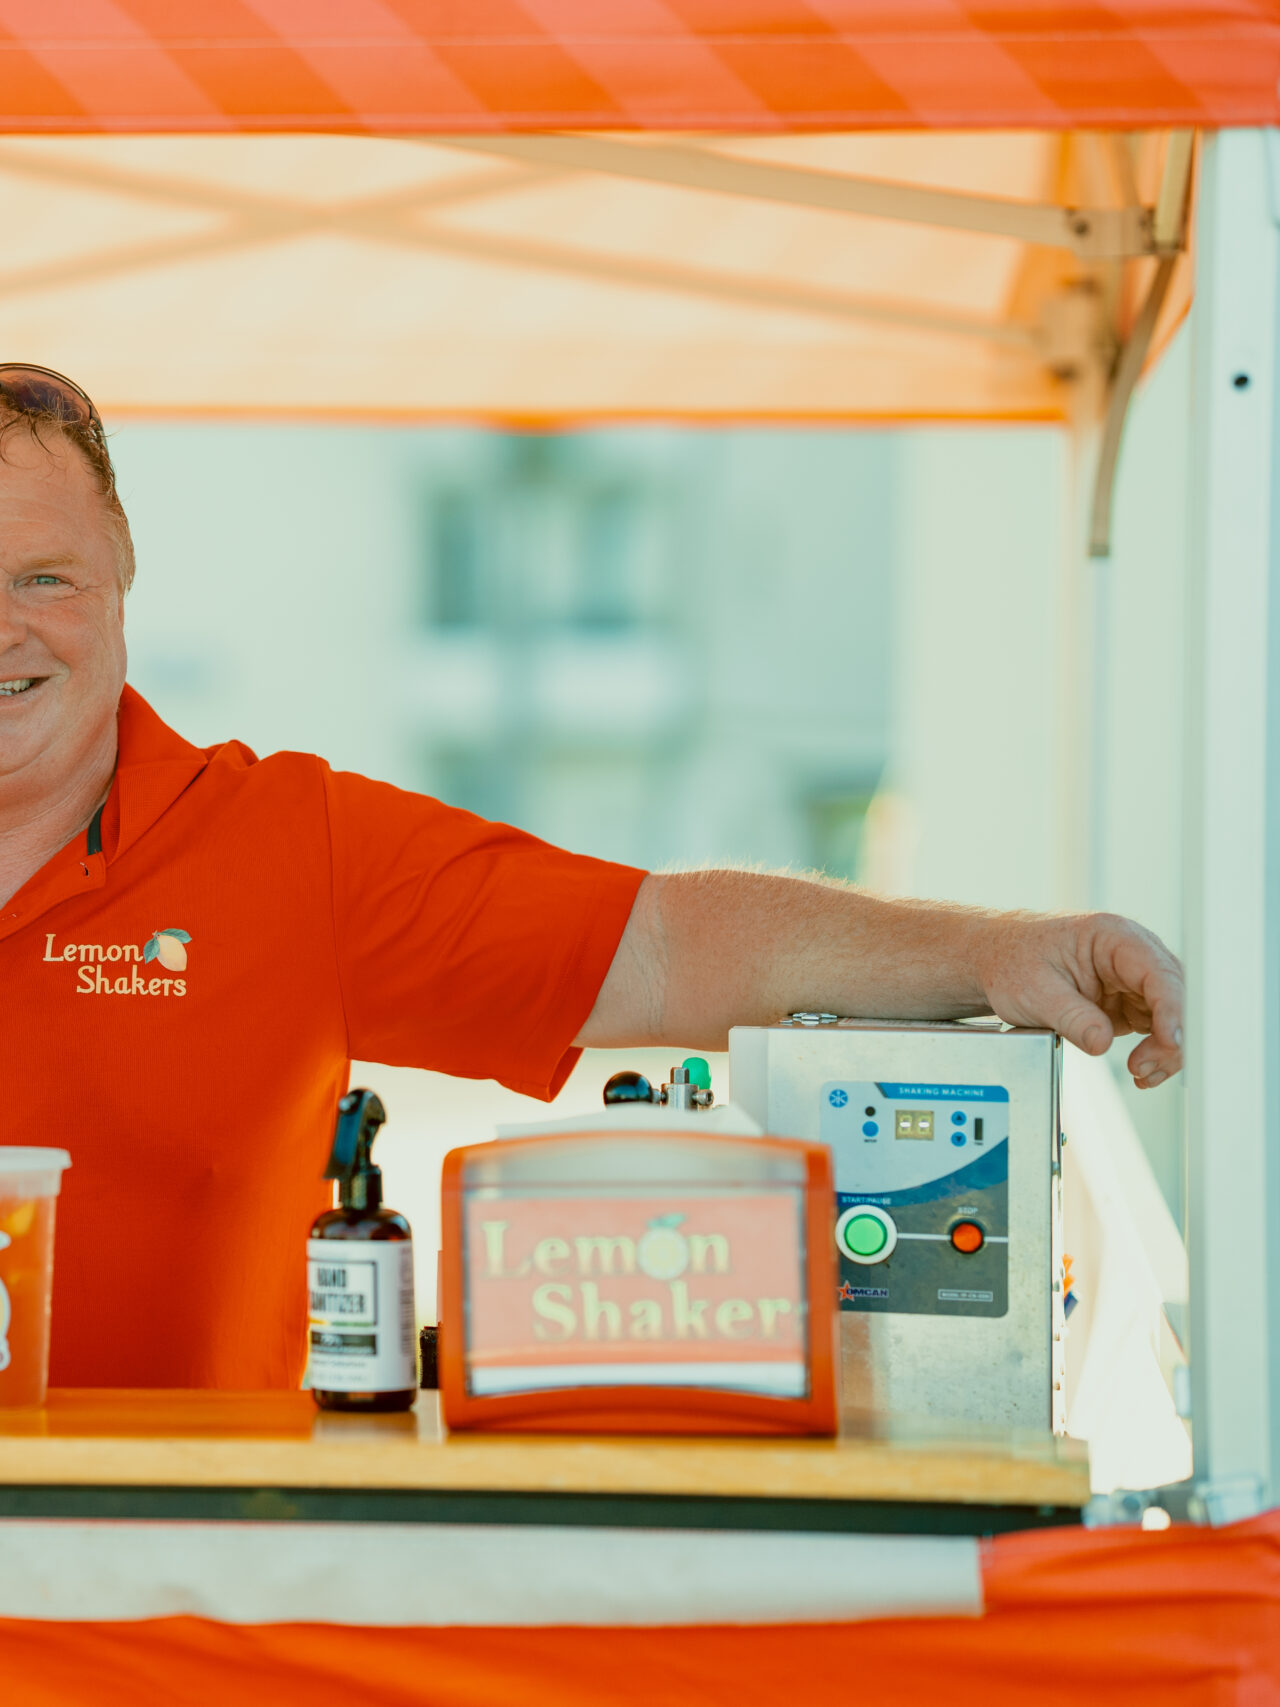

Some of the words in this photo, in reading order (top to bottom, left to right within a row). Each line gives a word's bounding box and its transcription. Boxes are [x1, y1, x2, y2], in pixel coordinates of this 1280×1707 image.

[42, 933, 144, 963] Lemon
[76, 964, 187, 997] Shakers
[898, 1087, 940, 1096] SHAKING
[941, 1088, 985, 1097] MACHINE
[957, 1206, 979, 1215] STOP
